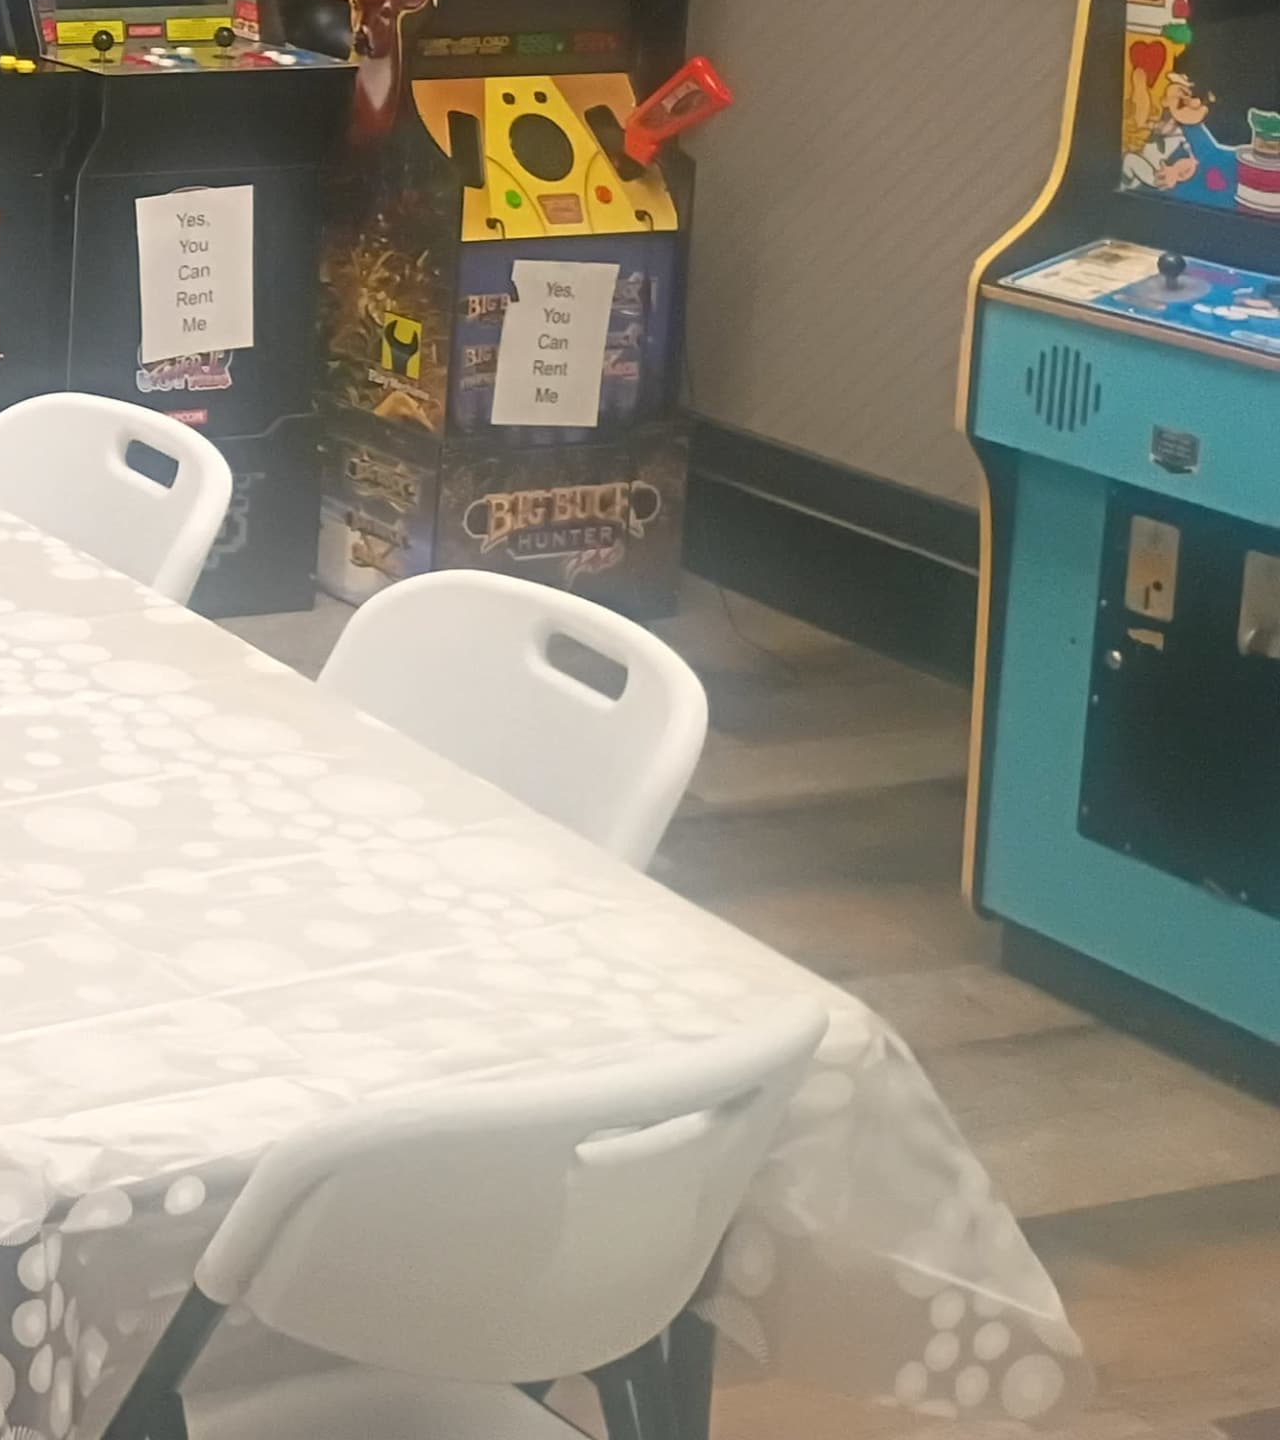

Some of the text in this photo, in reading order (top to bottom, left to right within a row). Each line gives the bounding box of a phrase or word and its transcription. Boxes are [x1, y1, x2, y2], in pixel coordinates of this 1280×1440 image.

[176, 212, 211, 228] Yes,
[179, 239, 209, 254] You
[178, 264, 211, 281] Can
[546, 280, 576, 299] Yes,
[176, 289, 214, 308] Rent
[182, 317, 207, 333] Me
[543, 308, 571, 325] You
[537, 333, 569, 350] Can
[532, 359, 568, 377] Rent
[534, 387, 559, 404] Me
[486, 490, 549, 541] BIG
[517, 526, 615, 552] HUNTER
